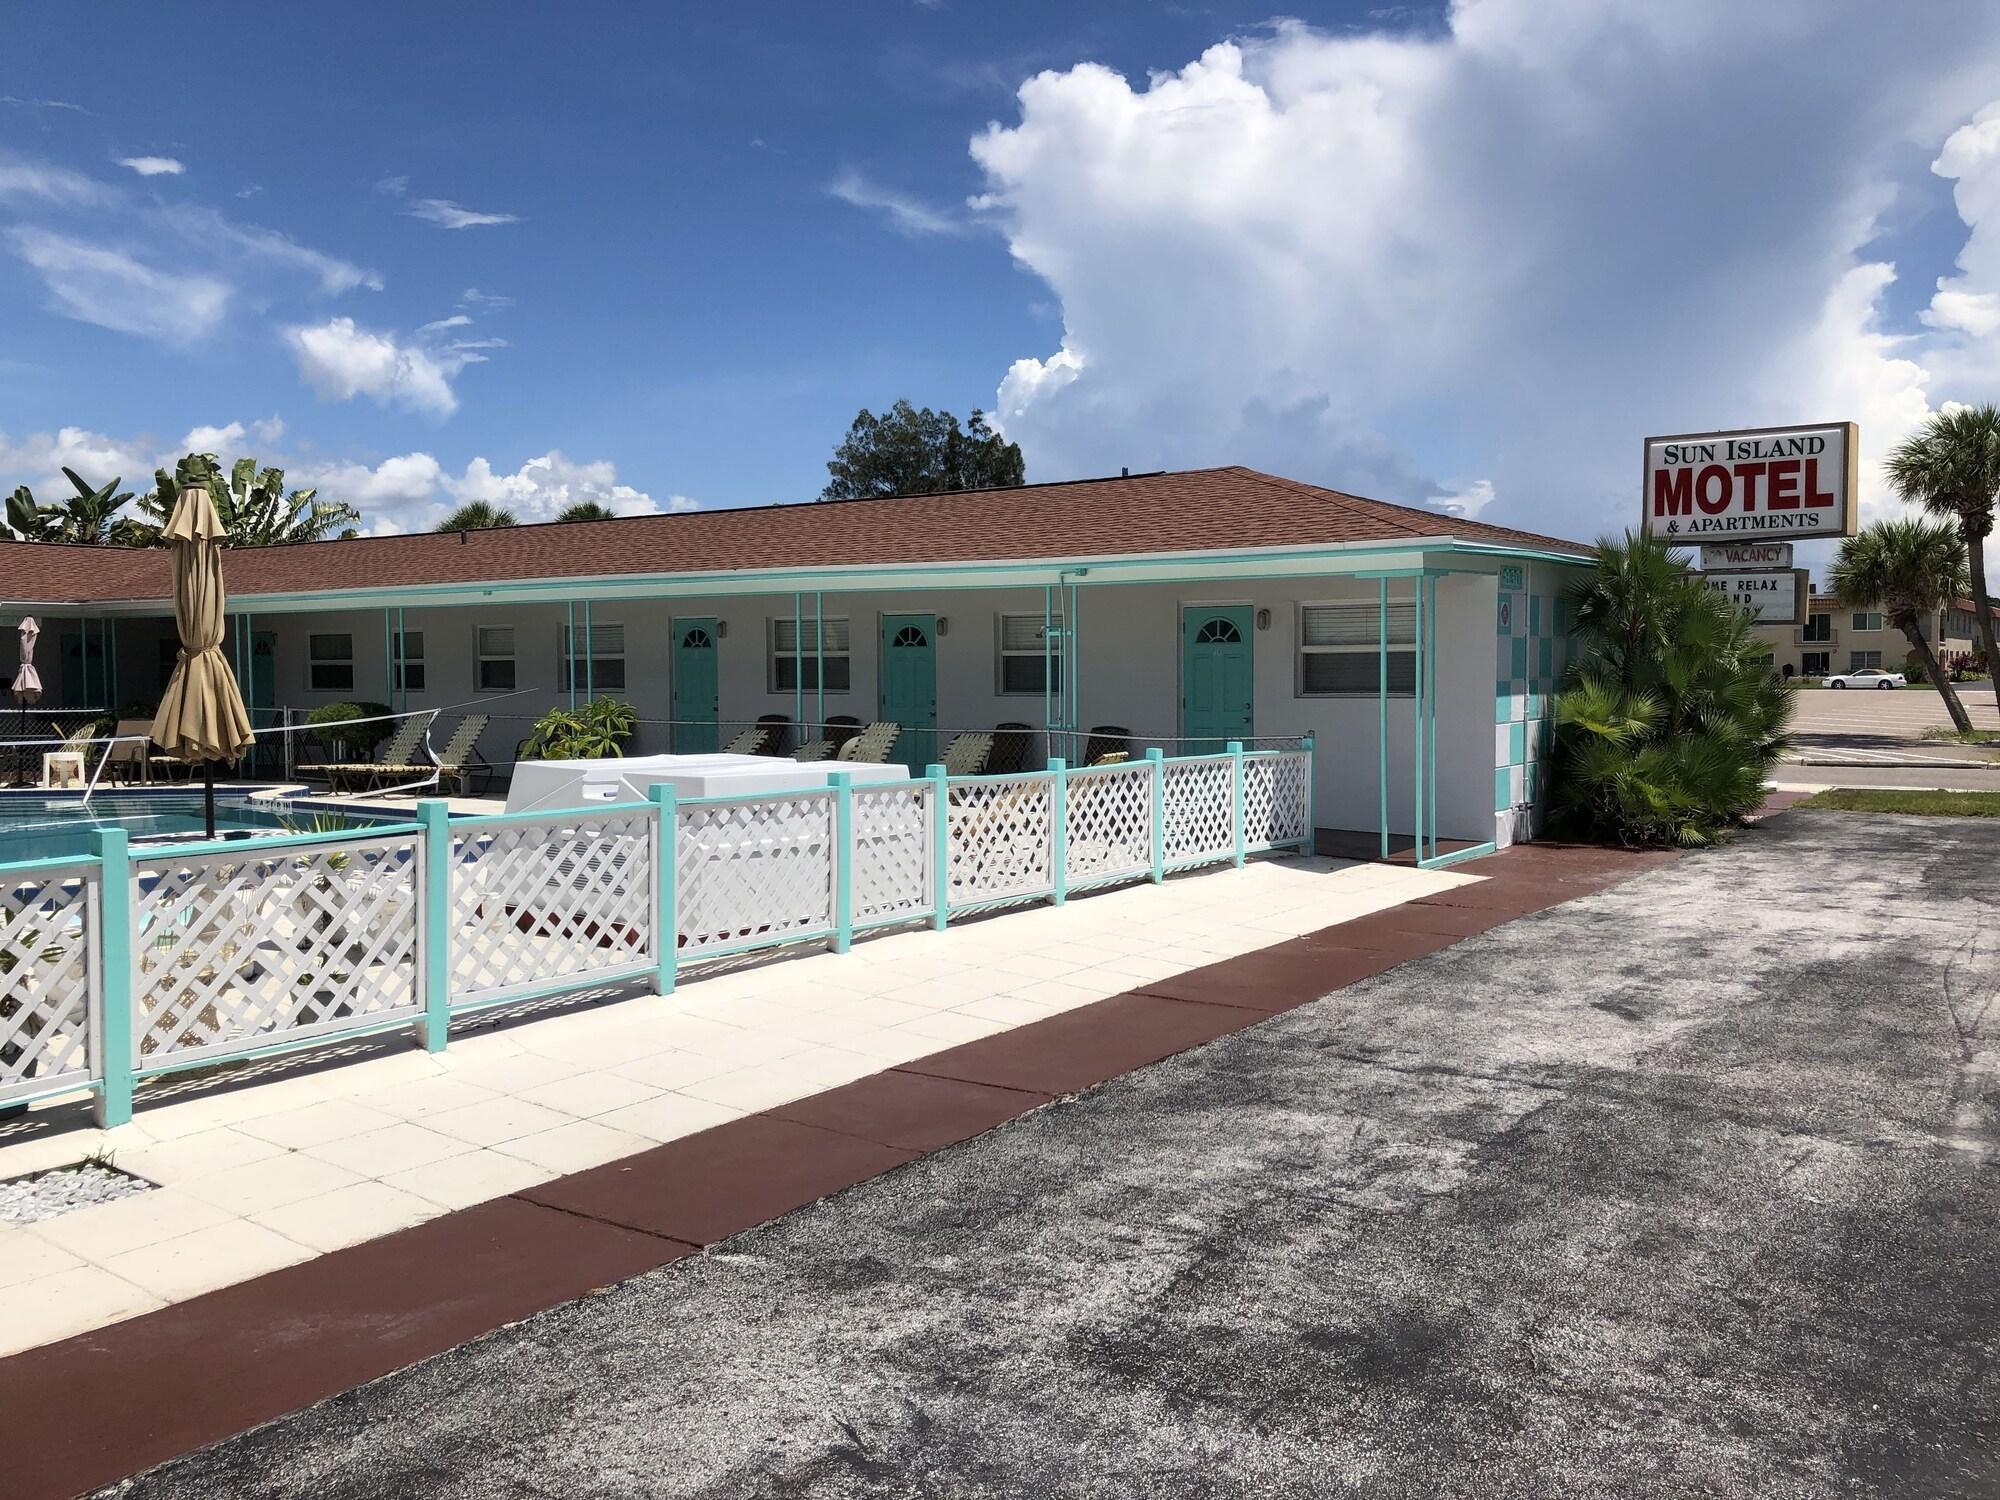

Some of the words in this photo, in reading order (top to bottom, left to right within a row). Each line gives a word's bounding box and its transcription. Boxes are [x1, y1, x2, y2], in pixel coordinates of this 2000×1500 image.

[1664, 443, 1716, 465] SUN
[1725, 436, 1825, 461] ISLAND
[1654, 458, 1834, 517] MOTEL
[1667, 519, 1680, 534] &
[1687, 512, 1819, 533] APARTMENTS
[1725, 547, 1782, 563] VACANCY
[1703, 580, 1727, 591] OME
[1737, 579, 1778, 591] RELAX
